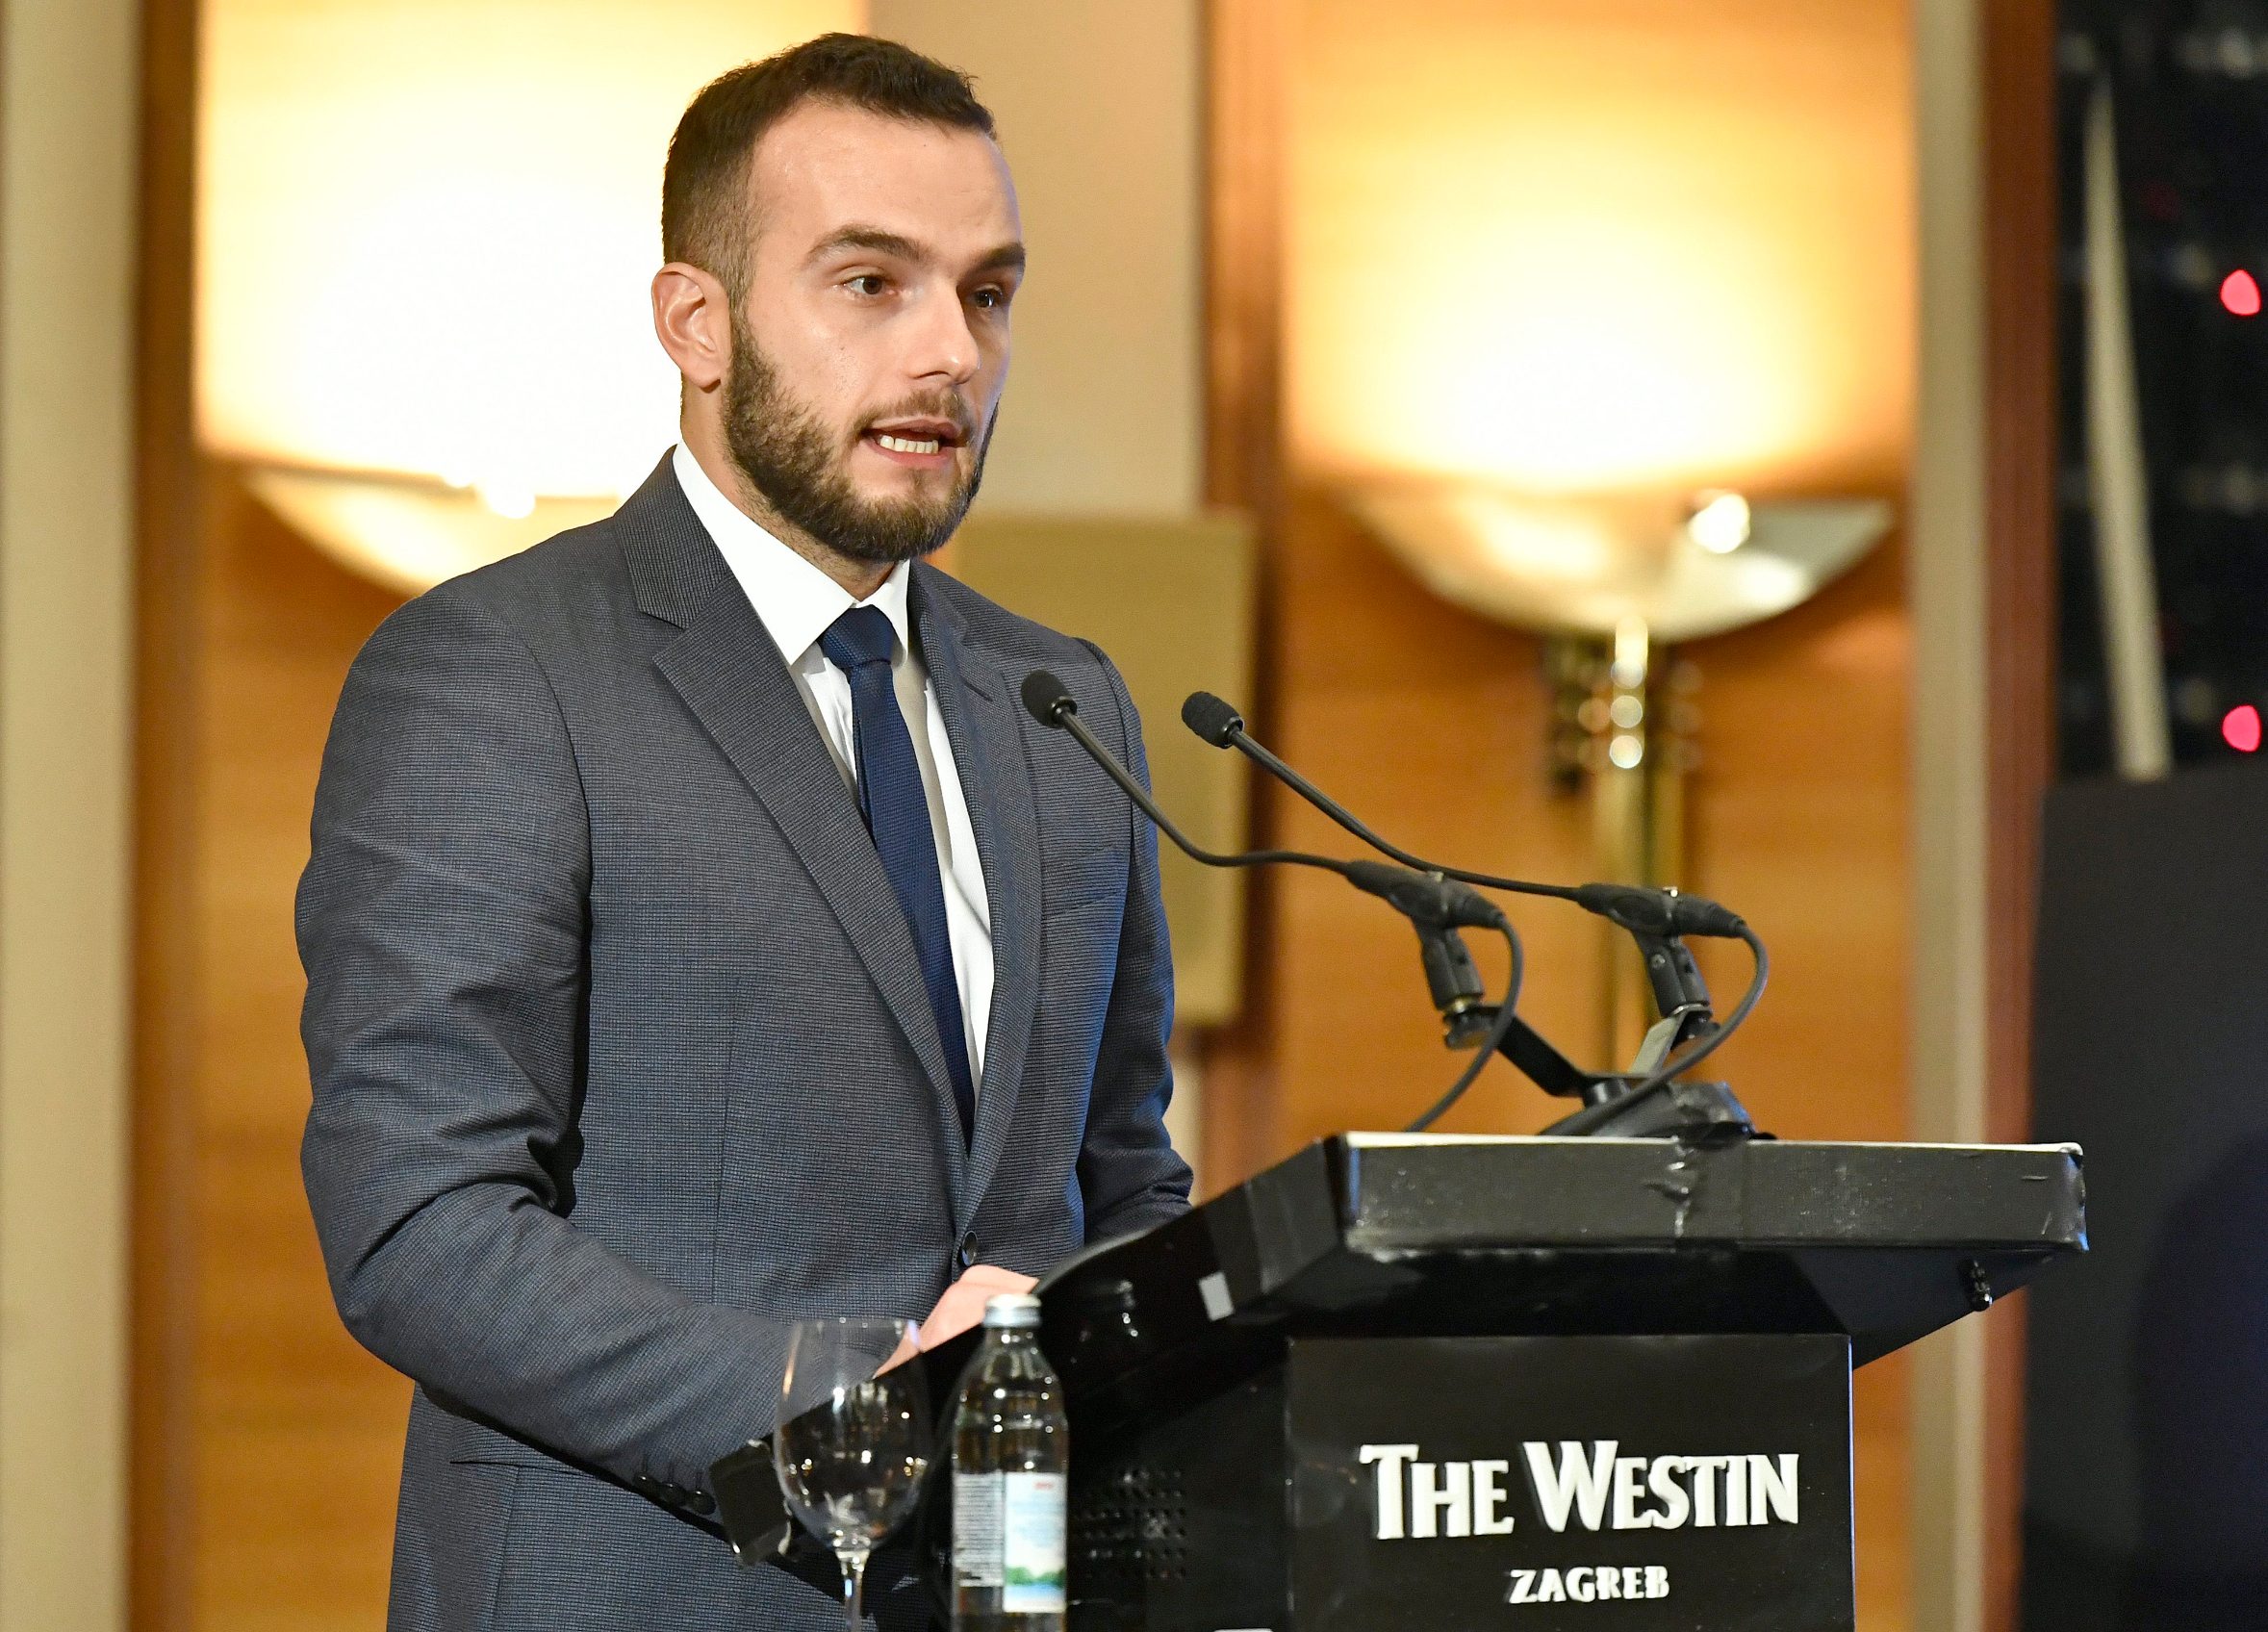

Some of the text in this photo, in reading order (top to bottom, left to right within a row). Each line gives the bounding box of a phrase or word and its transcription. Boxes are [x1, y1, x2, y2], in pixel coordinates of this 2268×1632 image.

[1359, 1440, 1799, 1540] THE WESTIN
[1509, 1566, 1670, 1604] ZAGREB
